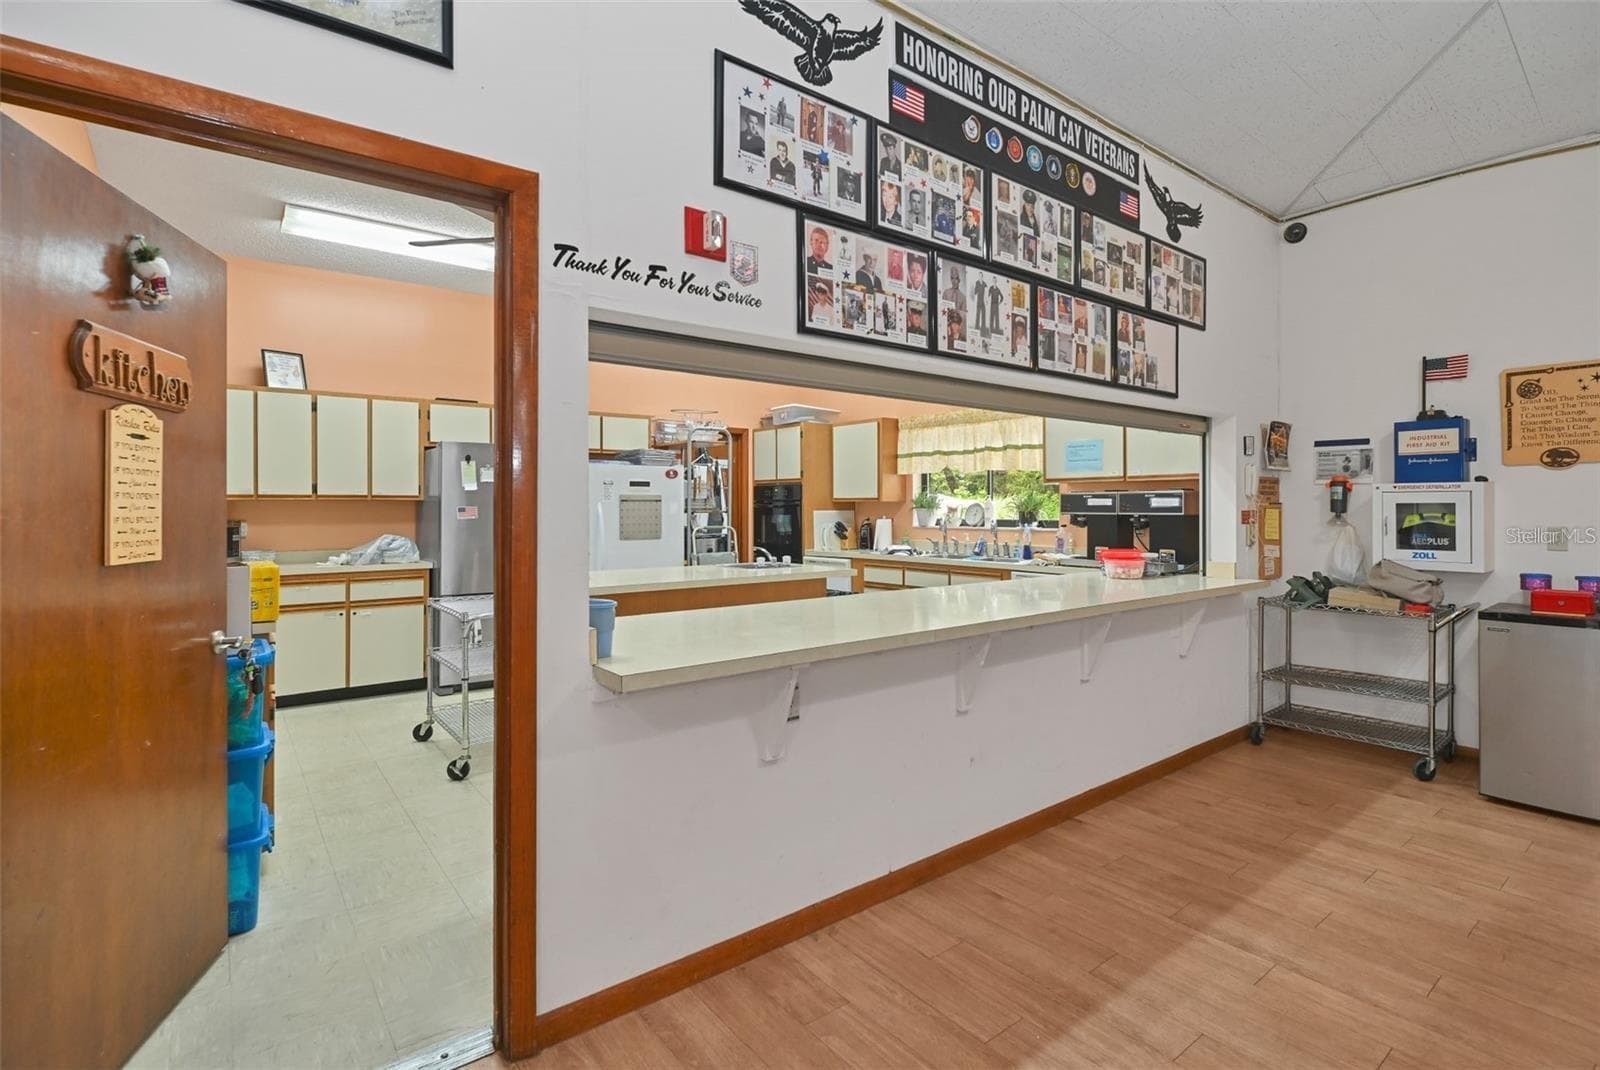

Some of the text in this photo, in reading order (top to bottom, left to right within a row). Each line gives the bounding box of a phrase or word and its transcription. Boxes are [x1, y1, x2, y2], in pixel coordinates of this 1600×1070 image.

[903, 31, 1135, 178] HONORING OUR PALM CAY VETERANS
[552, 243, 763, 308] Thank You For Your Service
[92, 335, 190, 407] kitchen
[1566, 415, 1597, 424] Change
[1539, 425, 1565, 434] Things
[1539, 432, 1557, 440] The
[1558, 430, 1591, 438] Wisdom
[1411, 551, 1437, 560] ZOLL
